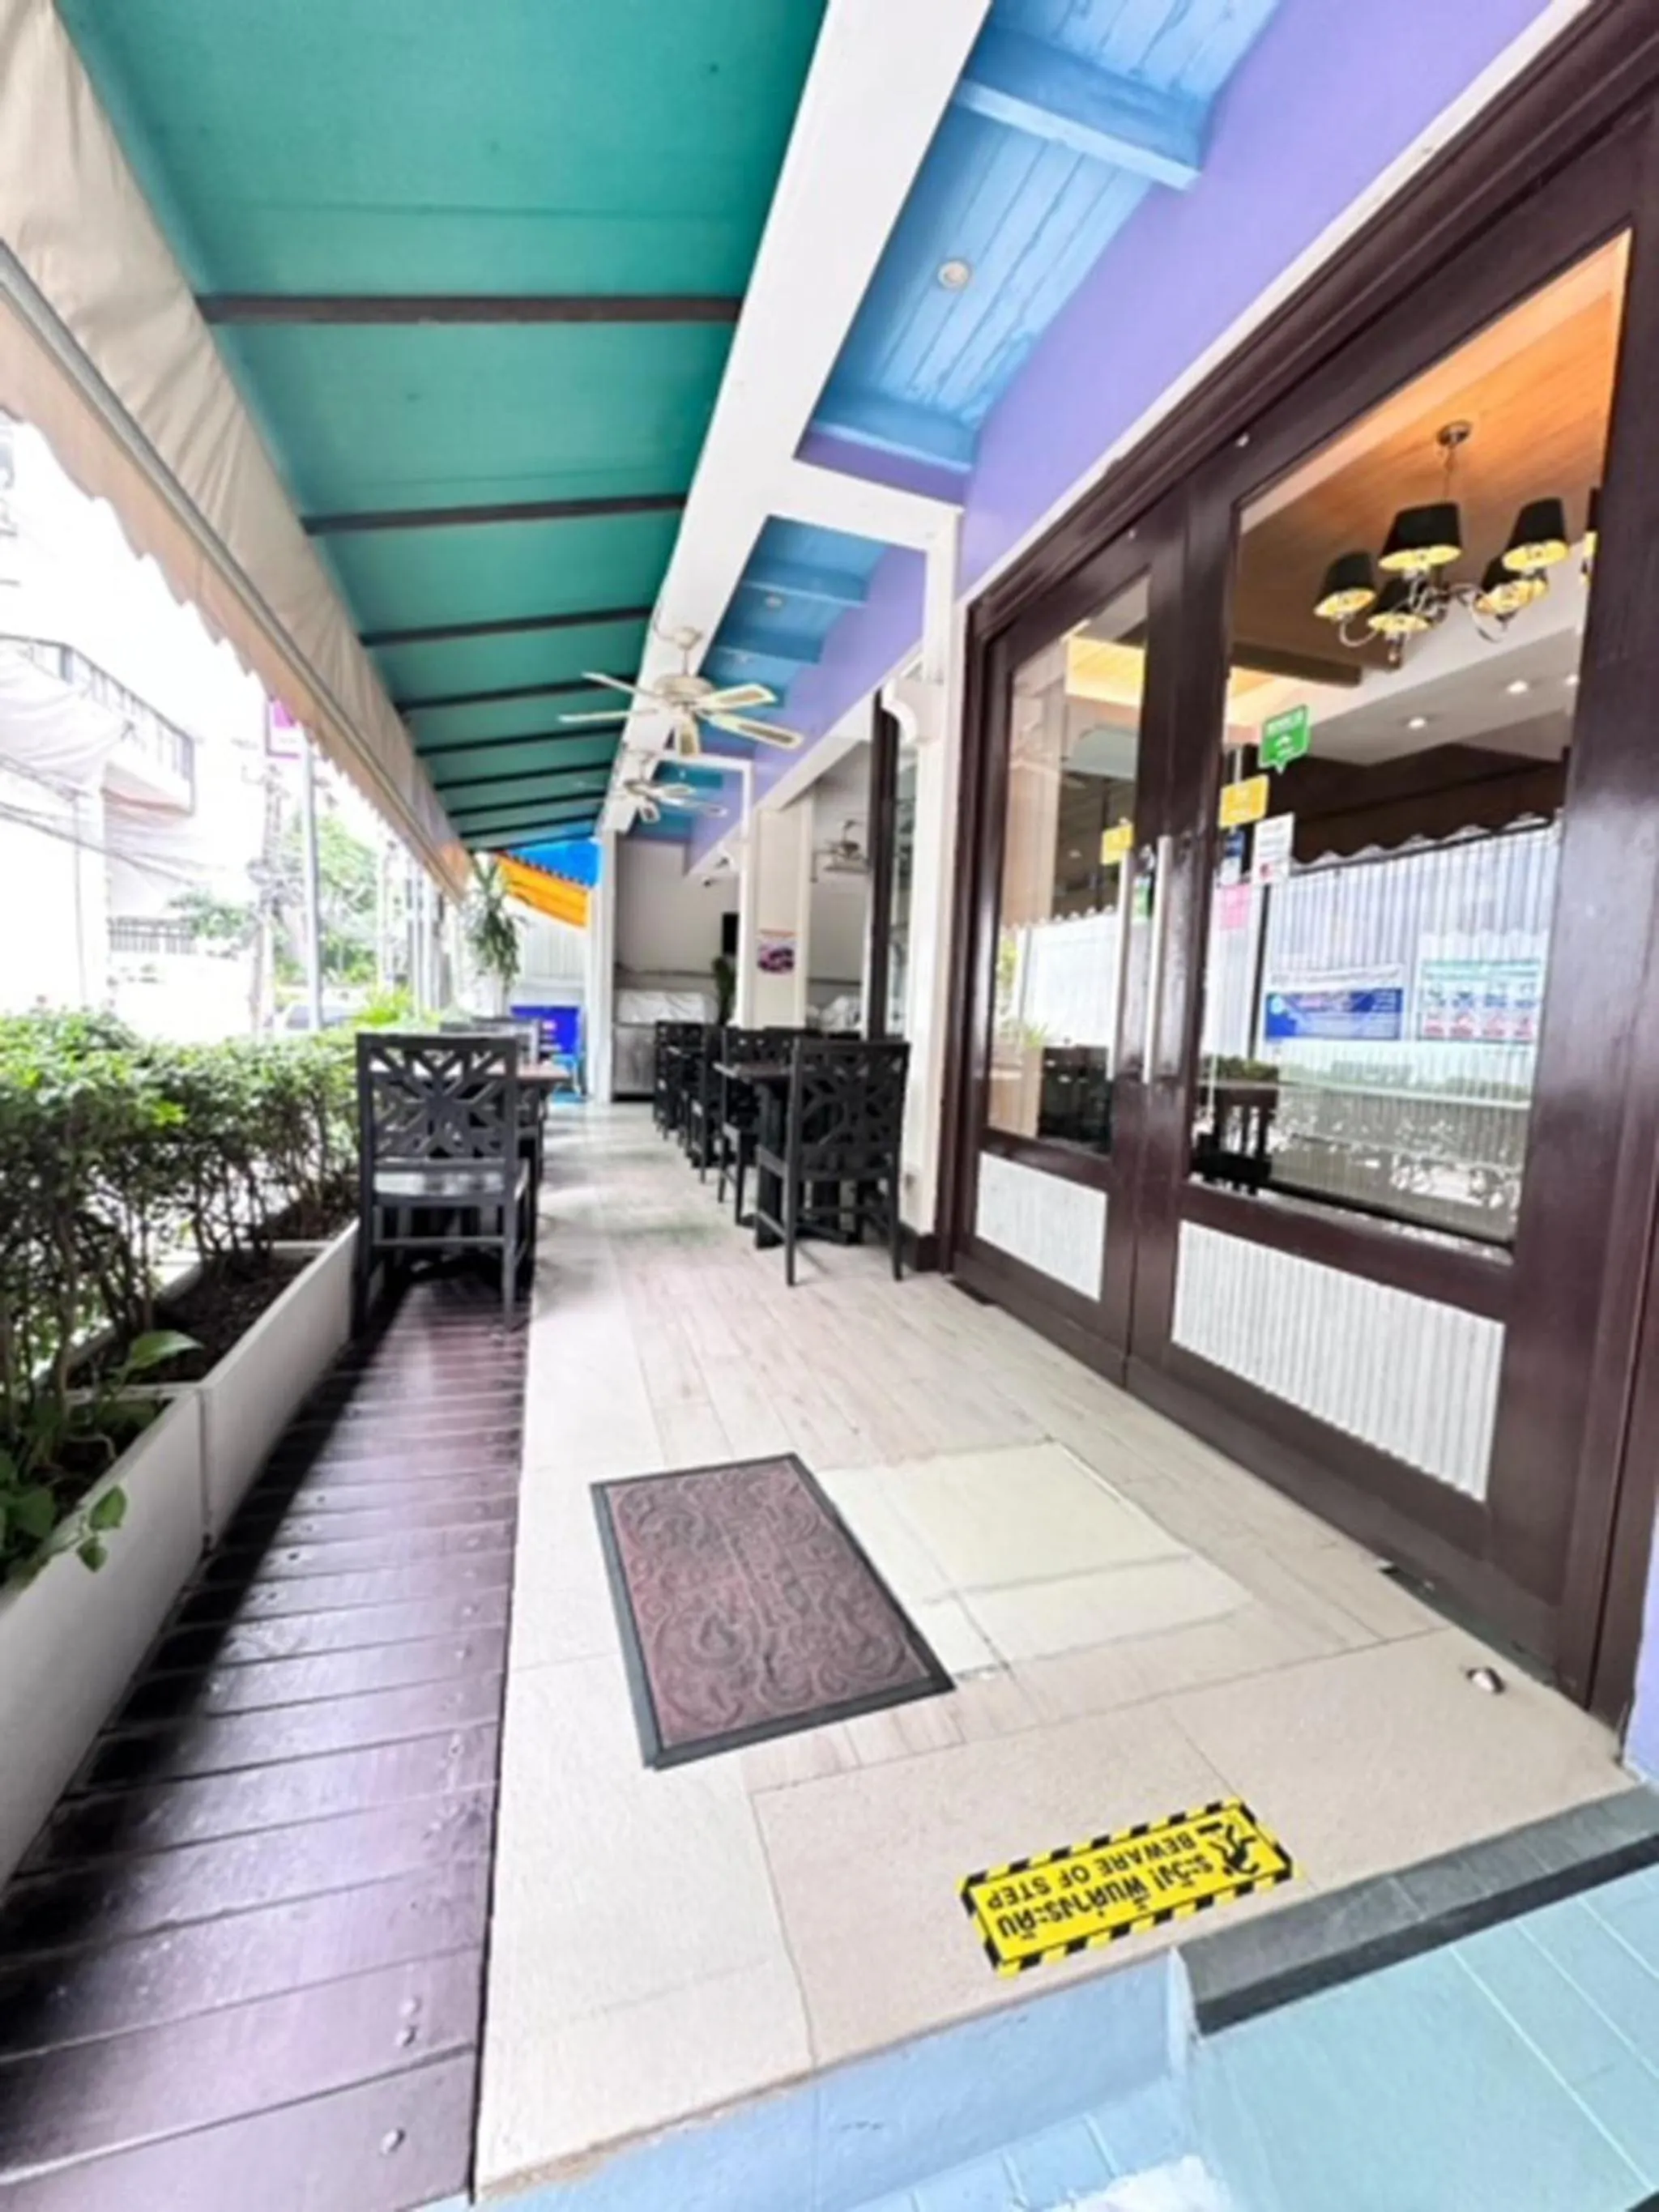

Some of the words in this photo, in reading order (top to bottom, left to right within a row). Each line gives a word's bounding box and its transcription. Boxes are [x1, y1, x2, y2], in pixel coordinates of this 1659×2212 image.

[1100, 1831, 1196, 1877] BEWARE
[1149, 1854, 1213, 1891] ระวัง!
[987, 1873, 1051, 1910] STEP
[1060, 1865, 1090, 1890] OF
